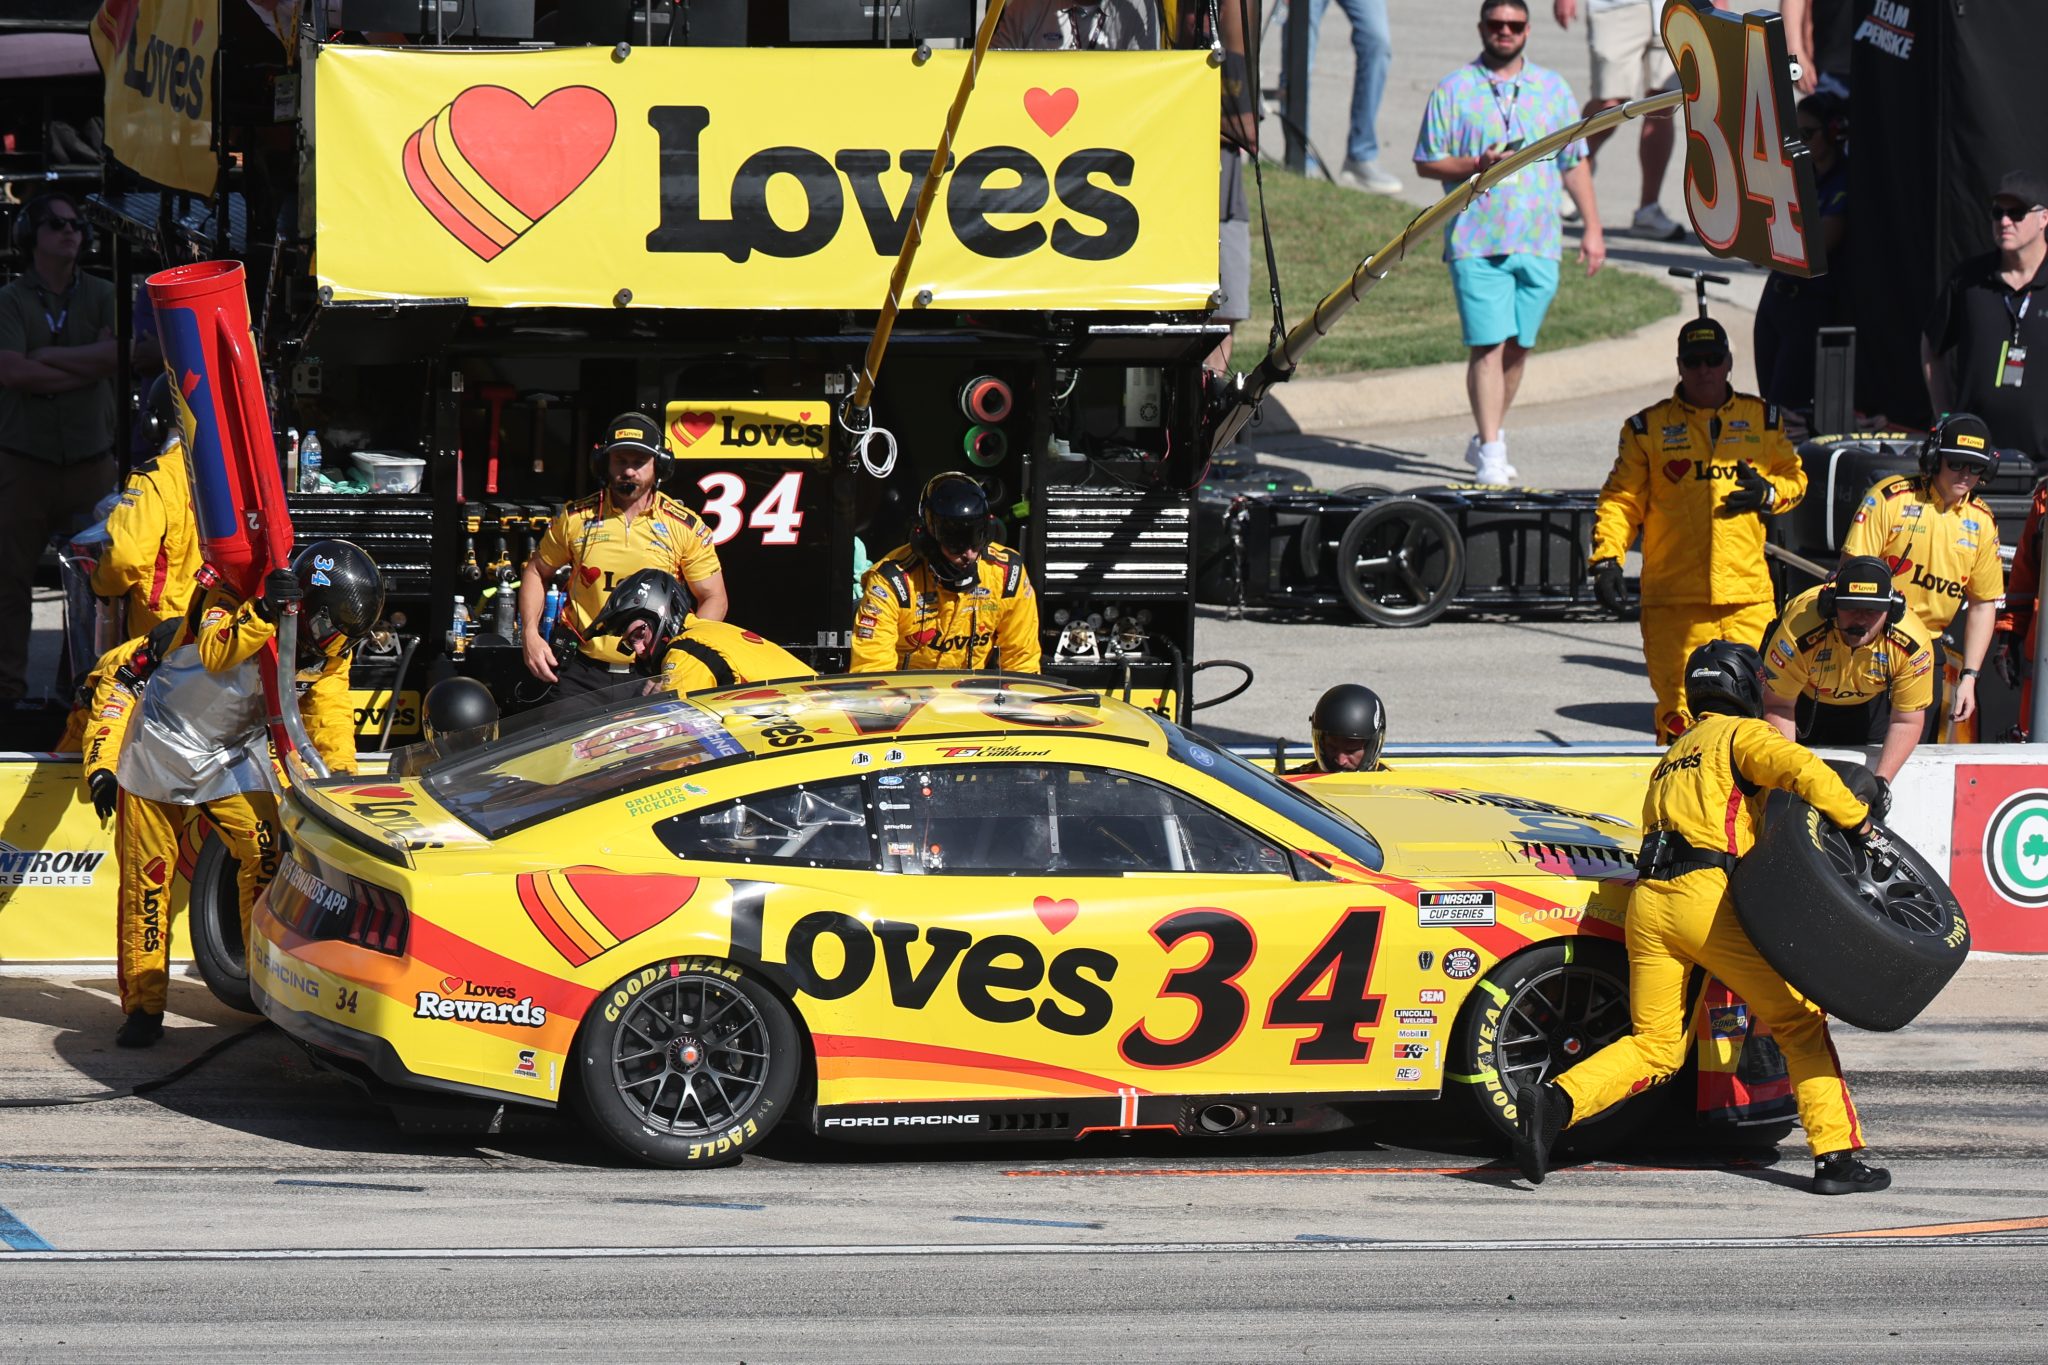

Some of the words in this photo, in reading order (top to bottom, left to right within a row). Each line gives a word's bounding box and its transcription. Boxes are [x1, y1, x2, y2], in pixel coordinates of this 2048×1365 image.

[1874, 0, 1909, 28] TEAM
[1854, 20, 1914, 60] PENSKE
[1664, 4, 1809, 269] 34
[1694, 461, 1757, 481] Lov
[697, 471, 805, 546] 34
[353, 707, 416, 727] oves
[625, 786, 682, 809] GRILLO'S
[629, 794, 686, 817] PICKLES
[288, 863, 328, 904] REWARDS
[322, 888, 348, 915] APP
[1442, 894, 1483, 904] NASCAR
[1429, 909, 1449, 919] CUP
[1451, 908, 1484, 919] SERIES
[1519, 903, 1625, 925] GOODYEA
[1447, 950, 1476, 961] NASCAR
[1446, 966, 1476, 978] SALUTES
[1117, 906, 1387, 1070] 34
[1420, 990, 1445, 1003] SEM
[335, 986, 359, 1014] 34
[415, 991, 547, 1028] Rewards
[1395, 1010, 1432, 1018] LINCOLN
[824, 1117, 889, 1128] FORD
[894, 1114, 980, 1126] RACING
[687, 1117, 758, 1160] EAGLE
